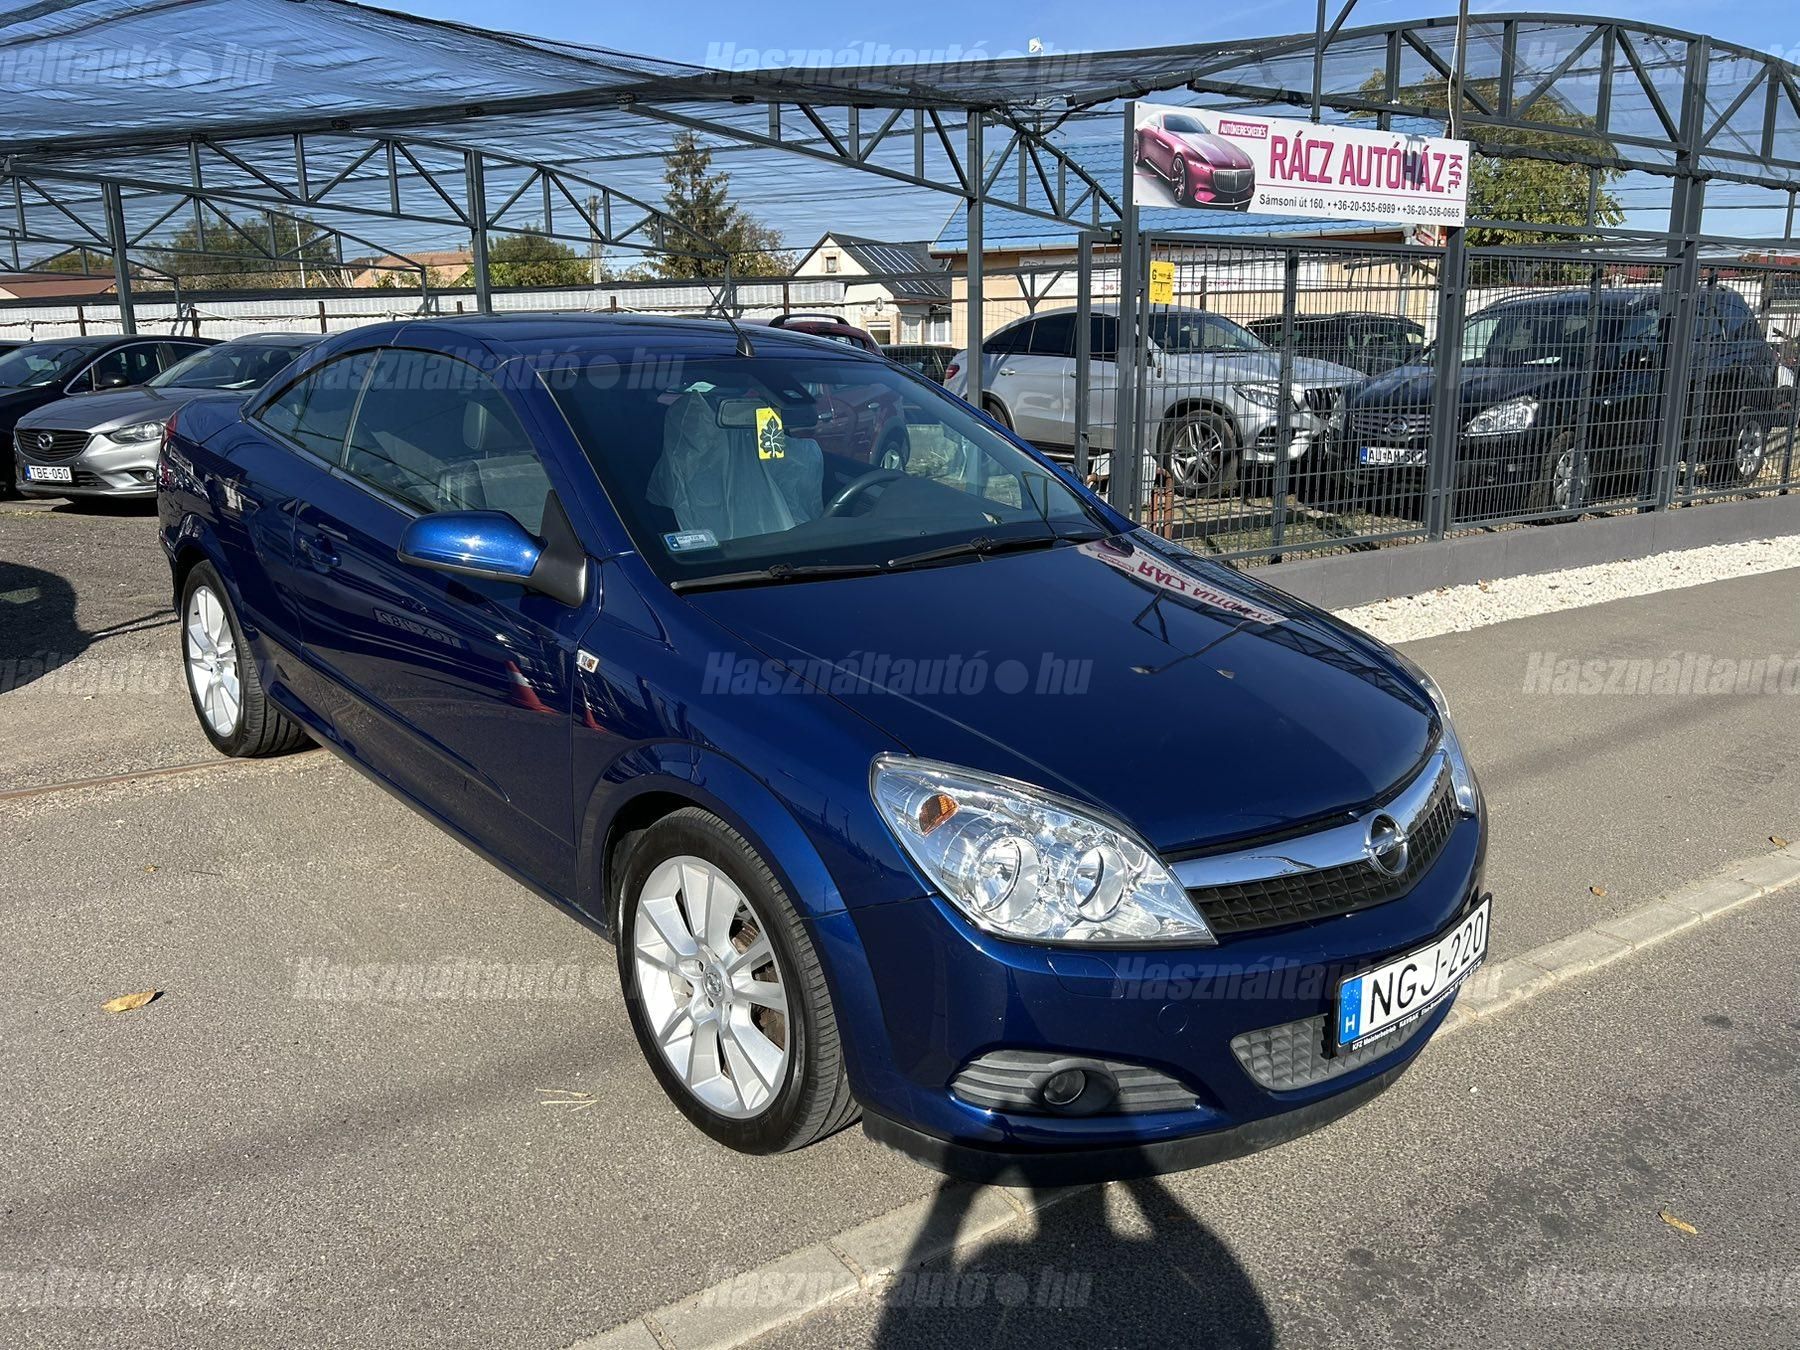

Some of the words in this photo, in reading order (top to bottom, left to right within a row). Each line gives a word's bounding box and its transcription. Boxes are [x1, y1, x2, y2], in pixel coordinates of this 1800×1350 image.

[1269, 130, 1334, 183] RÁCZ
[1339, 141, 1446, 193] AUTÓHÁZ
[1447, 155, 1463, 193] Kft.
[1259, 194, 1297, 208] Sámsoni
[1299, 196, 1308, 208] út
[1309, 198, 1326, 209] 160.
[1333, 200, 1396, 214] +36-20-535-6989
[31, 467, 70, 479] TBE-050
[1369, 911, 1484, 1025] NGJ-220
[1345, 1014, 1356, 1034] H
